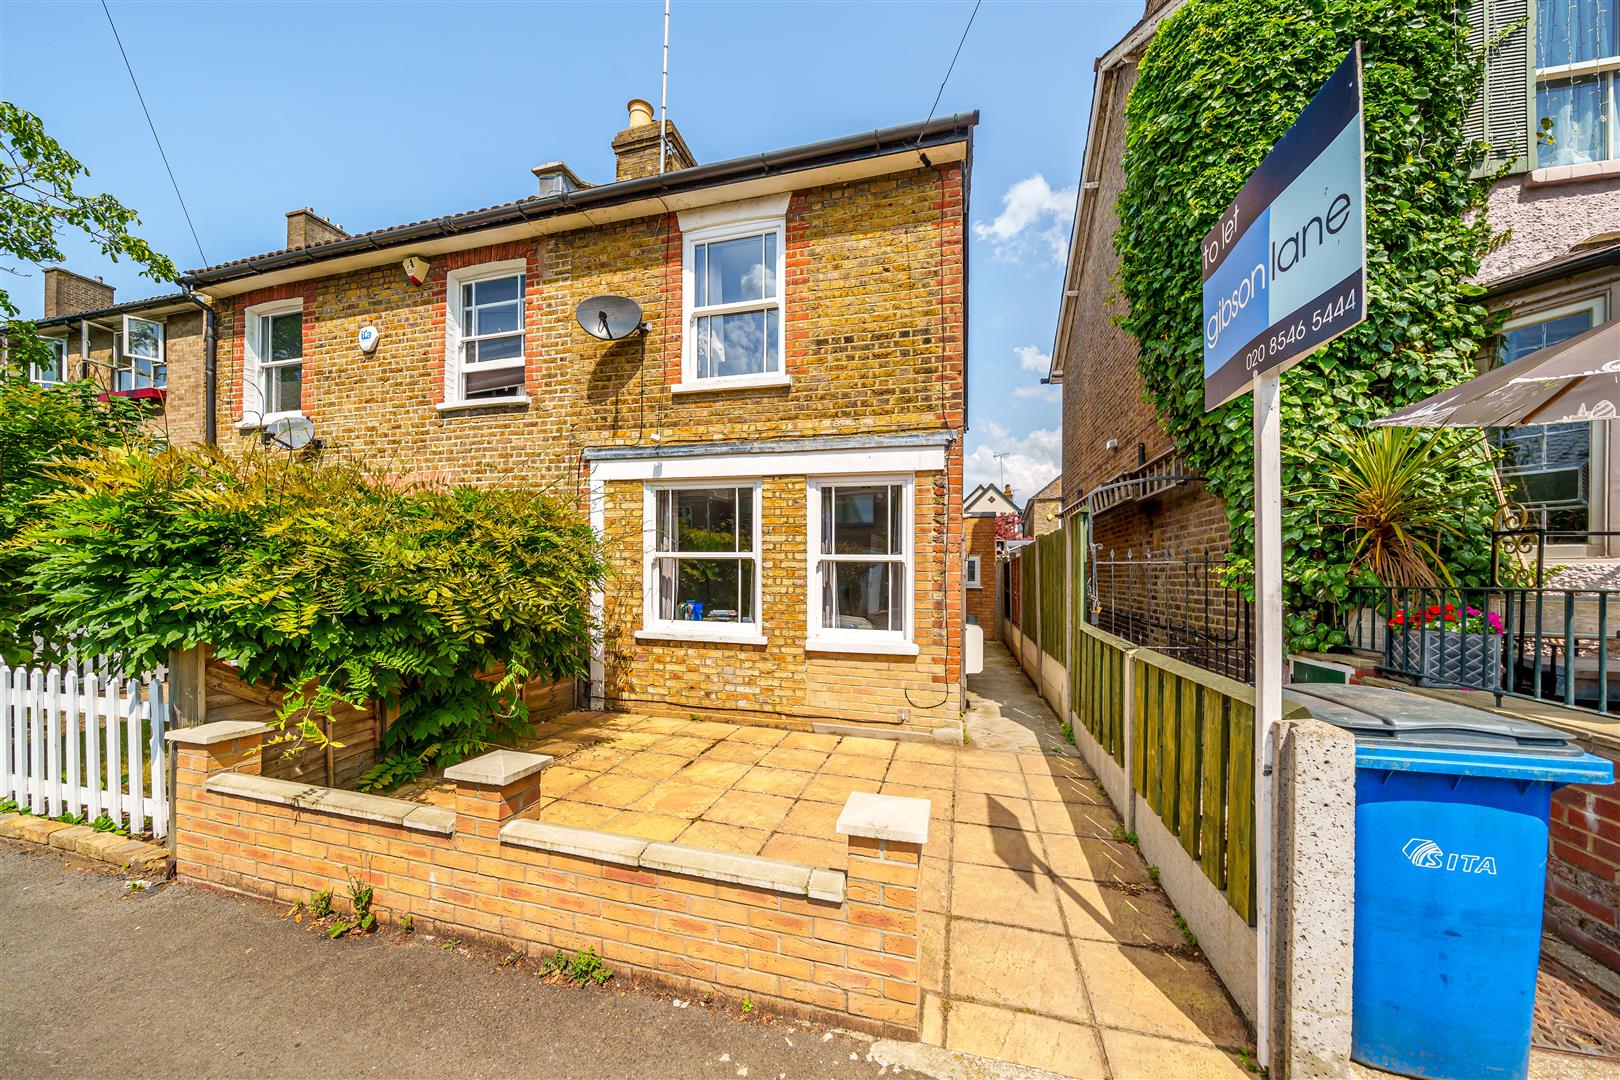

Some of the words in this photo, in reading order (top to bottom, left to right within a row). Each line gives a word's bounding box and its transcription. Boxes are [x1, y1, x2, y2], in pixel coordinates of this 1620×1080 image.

[1203, 240, 1218, 270] to
[1222, 204, 1239, 249] let
[1207, 263, 1265, 349] gibson
[1272, 193, 1350, 281] lane
[1246, 345, 1265, 371] 020
[1270, 320, 1305, 355] 8546
[1312, 289, 1356, 331] 5444
[1421, 850, 1497, 875] SITA
